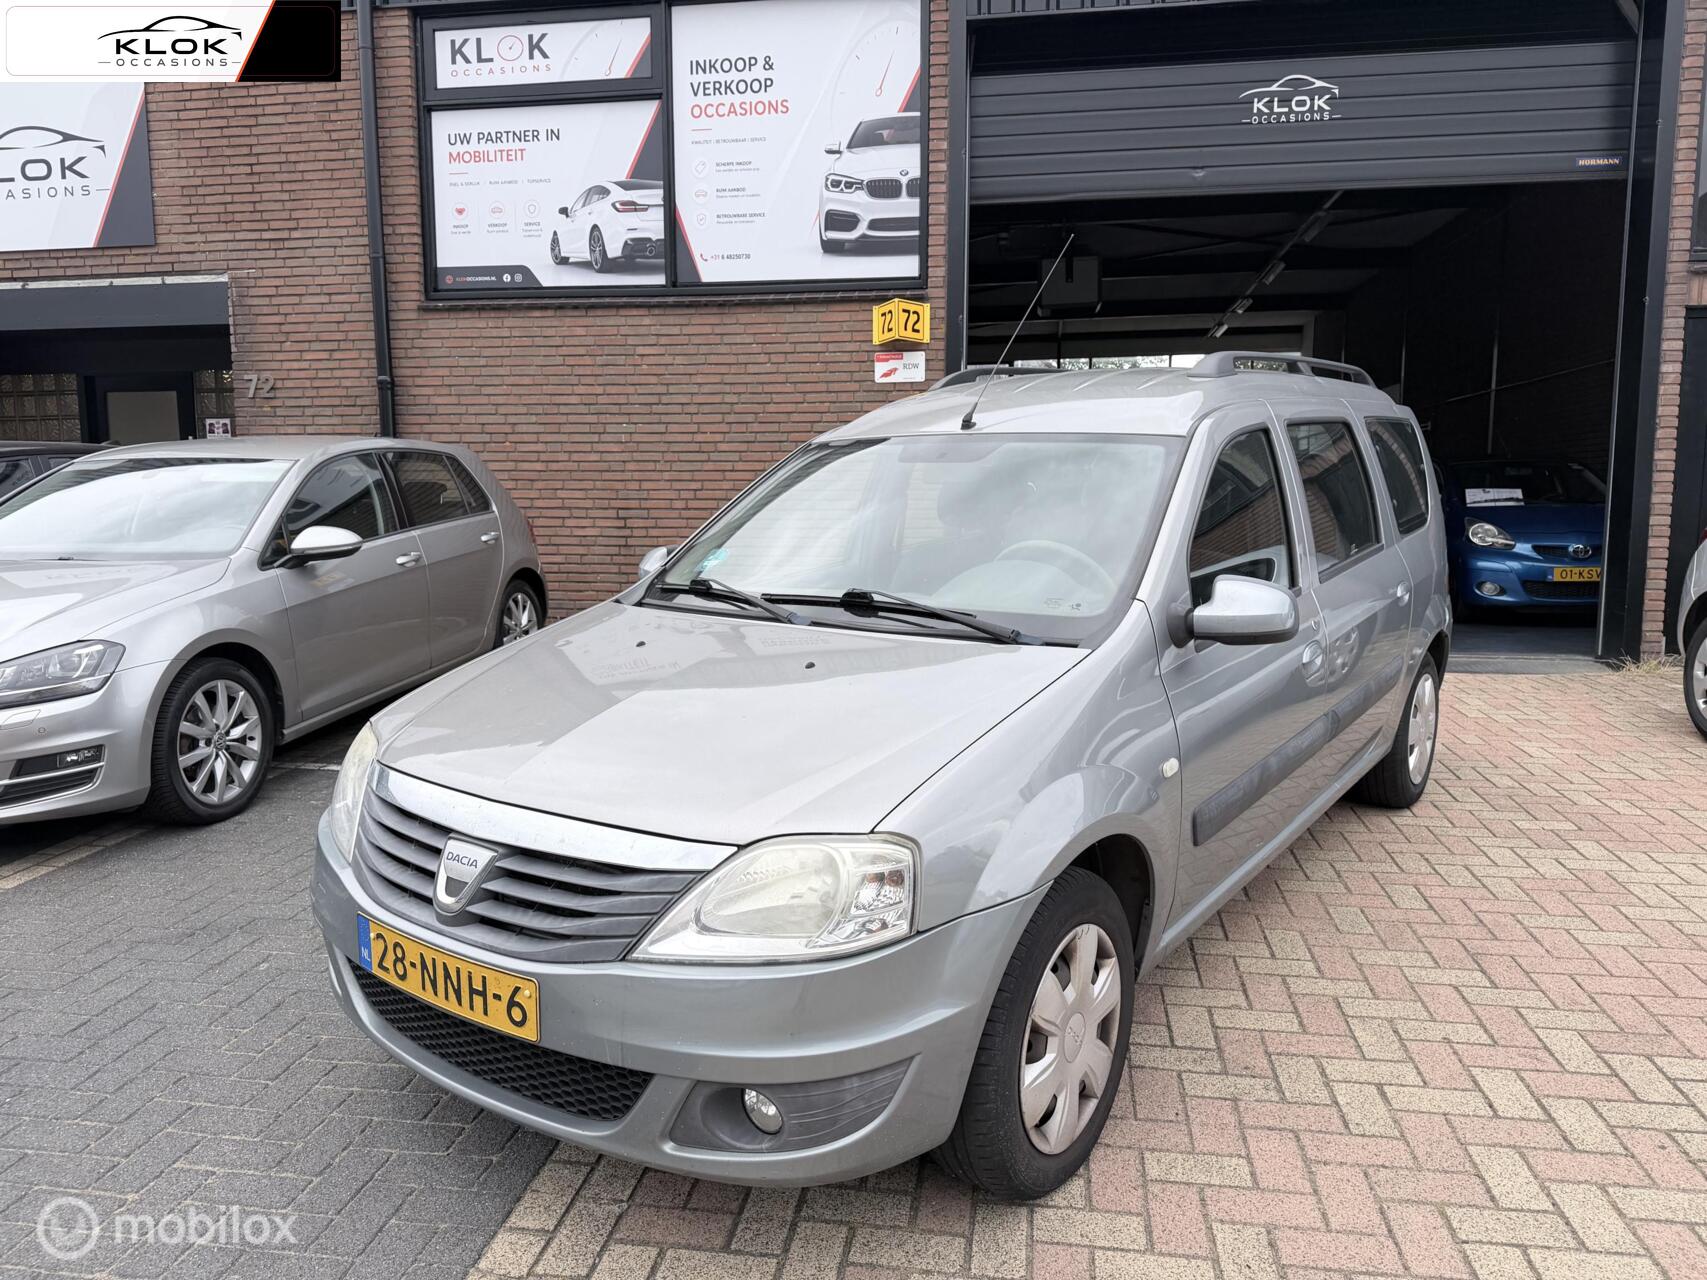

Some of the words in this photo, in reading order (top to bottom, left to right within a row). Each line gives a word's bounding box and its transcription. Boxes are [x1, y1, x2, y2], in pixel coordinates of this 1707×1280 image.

[451, 63, 552, 78] OCCASIONS
[690, 57, 758, 75] INKOOP
[763, 55, 775, 71] &
[690, 78, 774, 97] VERKOOP
[691, 99, 789, 119] OCCASIONS
[1253, 94, 1332, 113] KLOK
[1251, 111, 1330, 124] OCCASIONS
[448, 132, 472, 146] UW
[477, 129, 541, 145] PARTNER
[546, 128, 561, 142] IN
[448, 148, 527, 164] MOBILITEIT
[881, 309, 893, 335] 72
[902, 308, 920, 333] 72
[244, 374, 275, 399] 72
[446, 851, 478, 869] DACIA
[361, 947, 371, 961] NL
[374, 932, 528, 1028] 28-NNH-6
